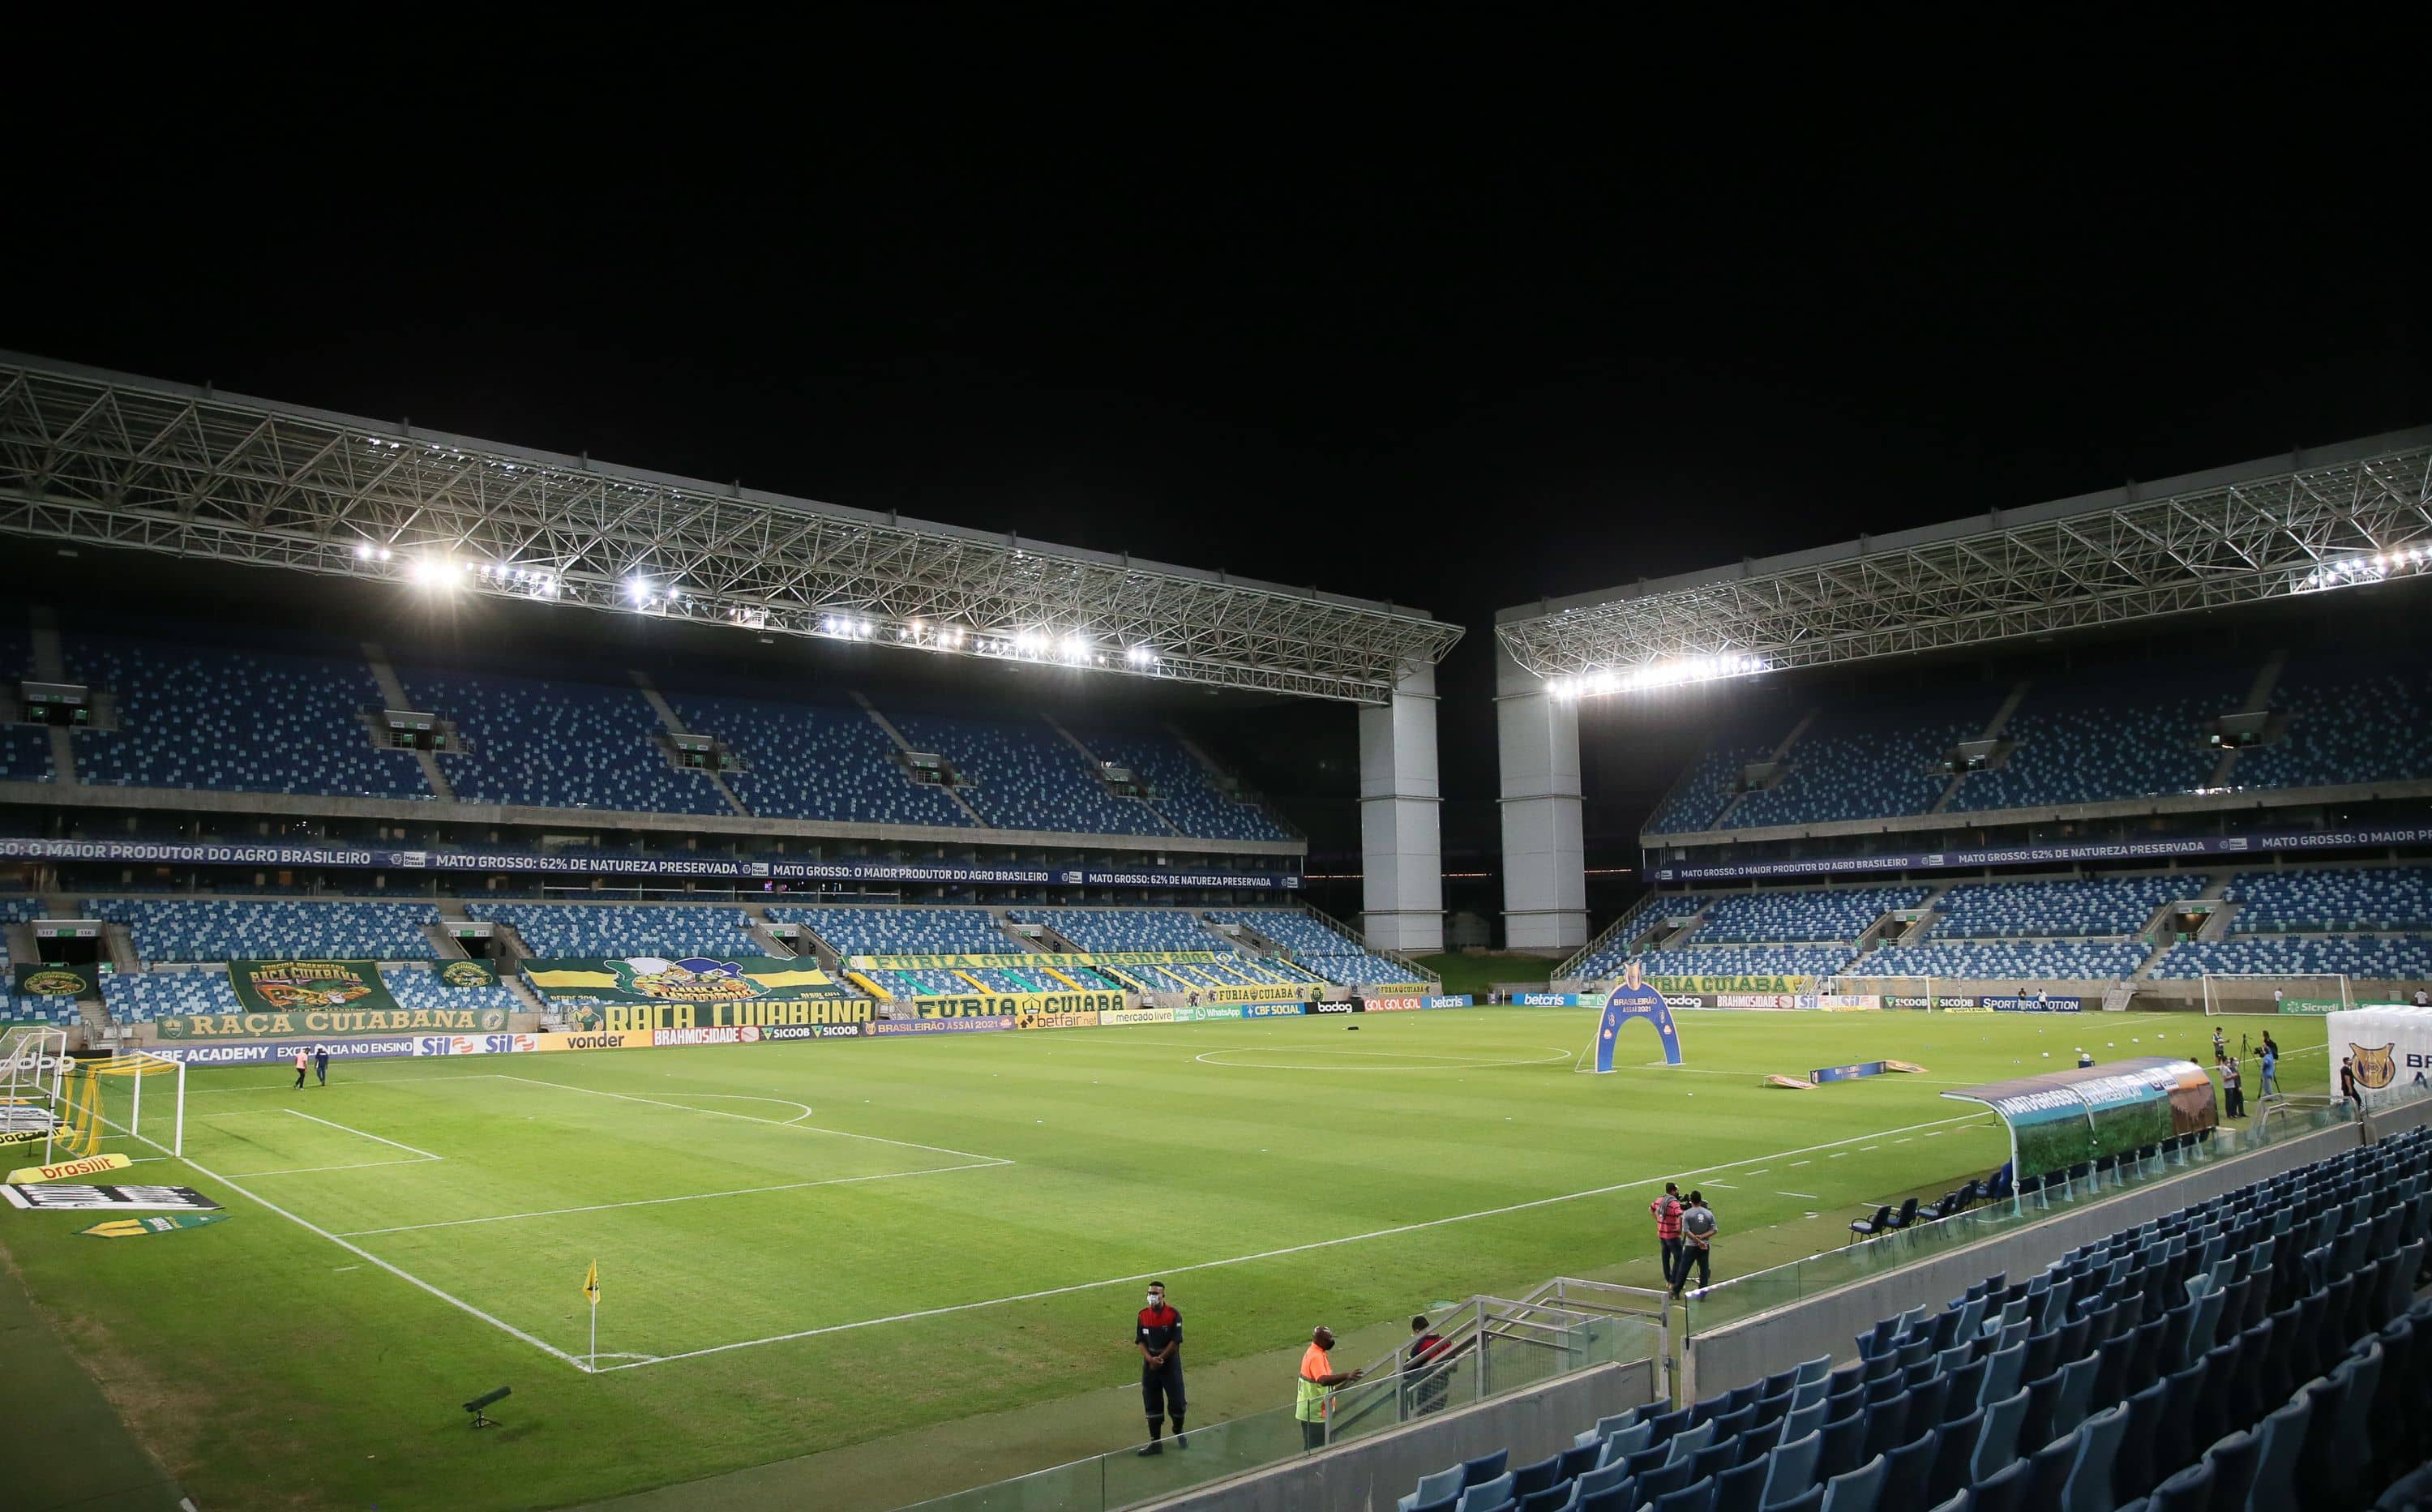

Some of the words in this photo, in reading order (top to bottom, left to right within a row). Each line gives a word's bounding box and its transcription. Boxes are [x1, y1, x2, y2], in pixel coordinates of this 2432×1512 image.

[2263, 837, 2297, 848] MATO
[2301, 833, 2356, 846] GROSSO:
[2359, 833, 2368, 843] O
[2374, 831, 2415, 842] MAIOR
[46, 843, 107, 859] MAIOR
[110, 846, 203, 861] PRODUTOR
[208, 848, 231, 862] DO
[234, 849, 277, 863] AGRO
[281, 850, 370, 865] BRASILEIRO
[1959, 854, 1985, 863] MATO
[1987, 851, 2030, 862] GROSSO:
[2032, 850, 2053, 859] 62%
[2055, 849, 2069, 859] DE
[2070, 846, 2129, 858] NATUREZA
[2130, 842, 2205, 854] PRESERVADA
[436, 855, 475, 867] MATO
[478, 855, 537, 869] GROSSO:
[539, 857, 567, 869] 62%
[570, 858, 587, 870] DE
[590, 859, 657, 872] NATUREZA
[659, 861, 738, 875] PRESERVADA
[1681, 869, 1702, 878] MATO
[1704, 867, 1737, 877] GROSSO:
[1738, 867, 1745, 876] O
[1745, 866, 1771, 875] MAIOR
[1773, 863, 1818, 873] PRODUTOR
[1818, 863, 1830, 872] DO
[1832, 861, 1855, 871] AGRO
[1856, 858, 1908, 870] BRASILEIRO
[773, 864, 803, 876] MATO
[807, 865, 852, 876] GROSSO:
[854, 866, 862, 876] O
[864, 867, 897, 878] MAIOR
[899, 867, 952, 880] PRODUTOR
[953, 871, 967, 880] DO
[969, 871, 995, 881] AGRO
[995, 872, 1049, 882] BRASILEIRO
[1089, 873, 1113, 883] MATO
[1114, 874, 1150, 884] GROSSO:
[1151, 876, 1167, 884] 62%
[1169, 876, 1180, 885] DE
[1181, 876, 1222, 886] NATUREZA
[1222, 876, 1271, 887] PRESERVADA
[1093, 953, 1168, 965] DESDE
[1171, 951, 1214, 964] 2003
[1365, 999, 1383, 1010] GOL
[1384, 999, 1402, 1009] GOL
[1403, 998, 1421, 1009] GOL
[1431, 996, 1463, 1008] betcris
[1524, 993, 1564, 1006] betcris
[1716, 995, 1779, 1009] BRAHMOSIDADE
[1799, 996, 1818, 1009] Sil
[1939, 998, 1974, 1008] SICOOB
[1982, 997, 2017, 1009] SPORT
[713, 998, 873, 1029] CUIABANA
[1206, 1008, 1240, 1017] WhatsApp
[1255, 1006, 1270, 1015] CBF
[1271, 1004, 1301, 1014] SOCIAL
[1317, 1001, 1353, 1013] bodog
[2301, 1003, 2339, 1013] Sicredi
[1115, 1012, 1154, 1022] mercado
[1155, 1010, 1172, 1020] livre
[190, 1015, 294, 1038] RAÇA
[306, 1010, 476, 1033] CUIABANA
[823, 1025, 858, 1036] SICOOB
[878, 1021, 945, 1034] BRASILEIRÃO
[975, 1019, 999, 1029] 2021
[654, 1026, 740, 1047] BRAHMOSIDADE
[773, 1026, 810, 1039] SICOOB
[352, 1043, 369, 1054] NO
[370, 1041, 413, 1053] ENSINO
[421, 1036, 451, 1056] Sil
[485, 1034, 514, 1054] Sil
[567, 1033, 625, 1050] vonder
[186, 1047, 268, 1062] ACADEMY
[38, 1156, 116, 1180] brasilit
